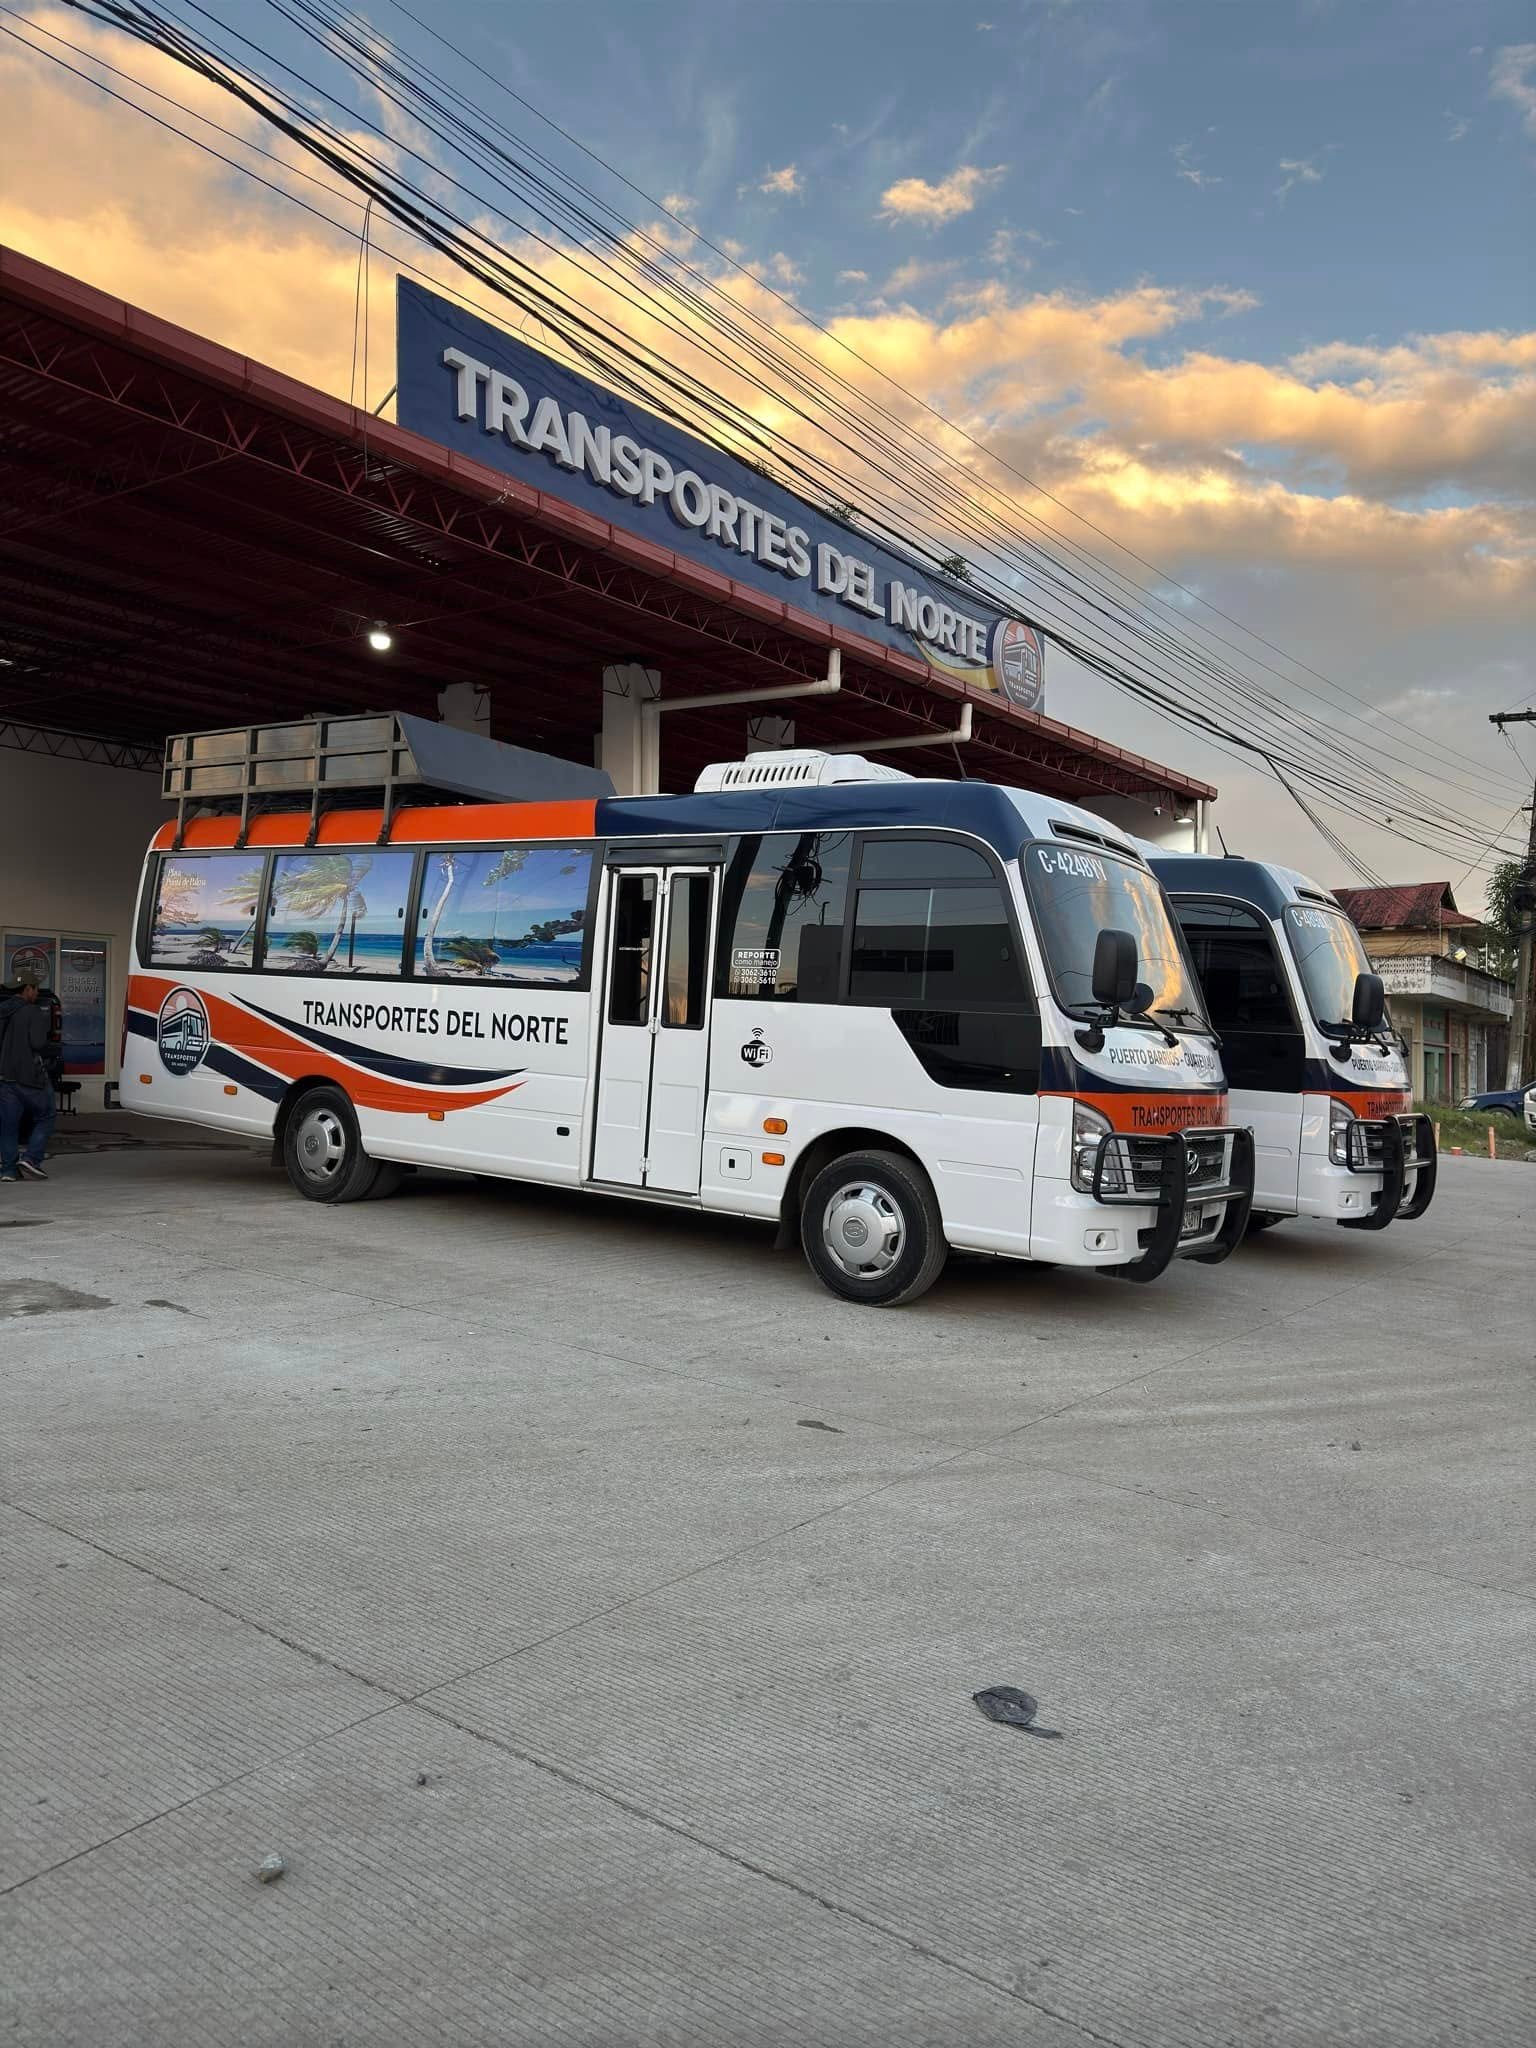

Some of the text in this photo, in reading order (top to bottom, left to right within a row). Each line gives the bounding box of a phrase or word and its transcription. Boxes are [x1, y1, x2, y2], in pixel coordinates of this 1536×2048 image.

[443, 346, 988, 665] TRANSPORTES DEL NORTE
[737, 951, 776, 959] REPORTE
[753, 959, 778, 968] manejo
[741, 969, 777, 977] 3062-3610
[303, 1000, 569, 1045] TRANSPORTES DEL NORTE
[164, 1052, 197, 1062] TRANSPORTES
[1109, 1048, 1147, 1064] PUERTO
[1148, 1051, 1180, 1067] BARRIOS
[1131, 1106, 1195, 1127] TRANSPORTES
